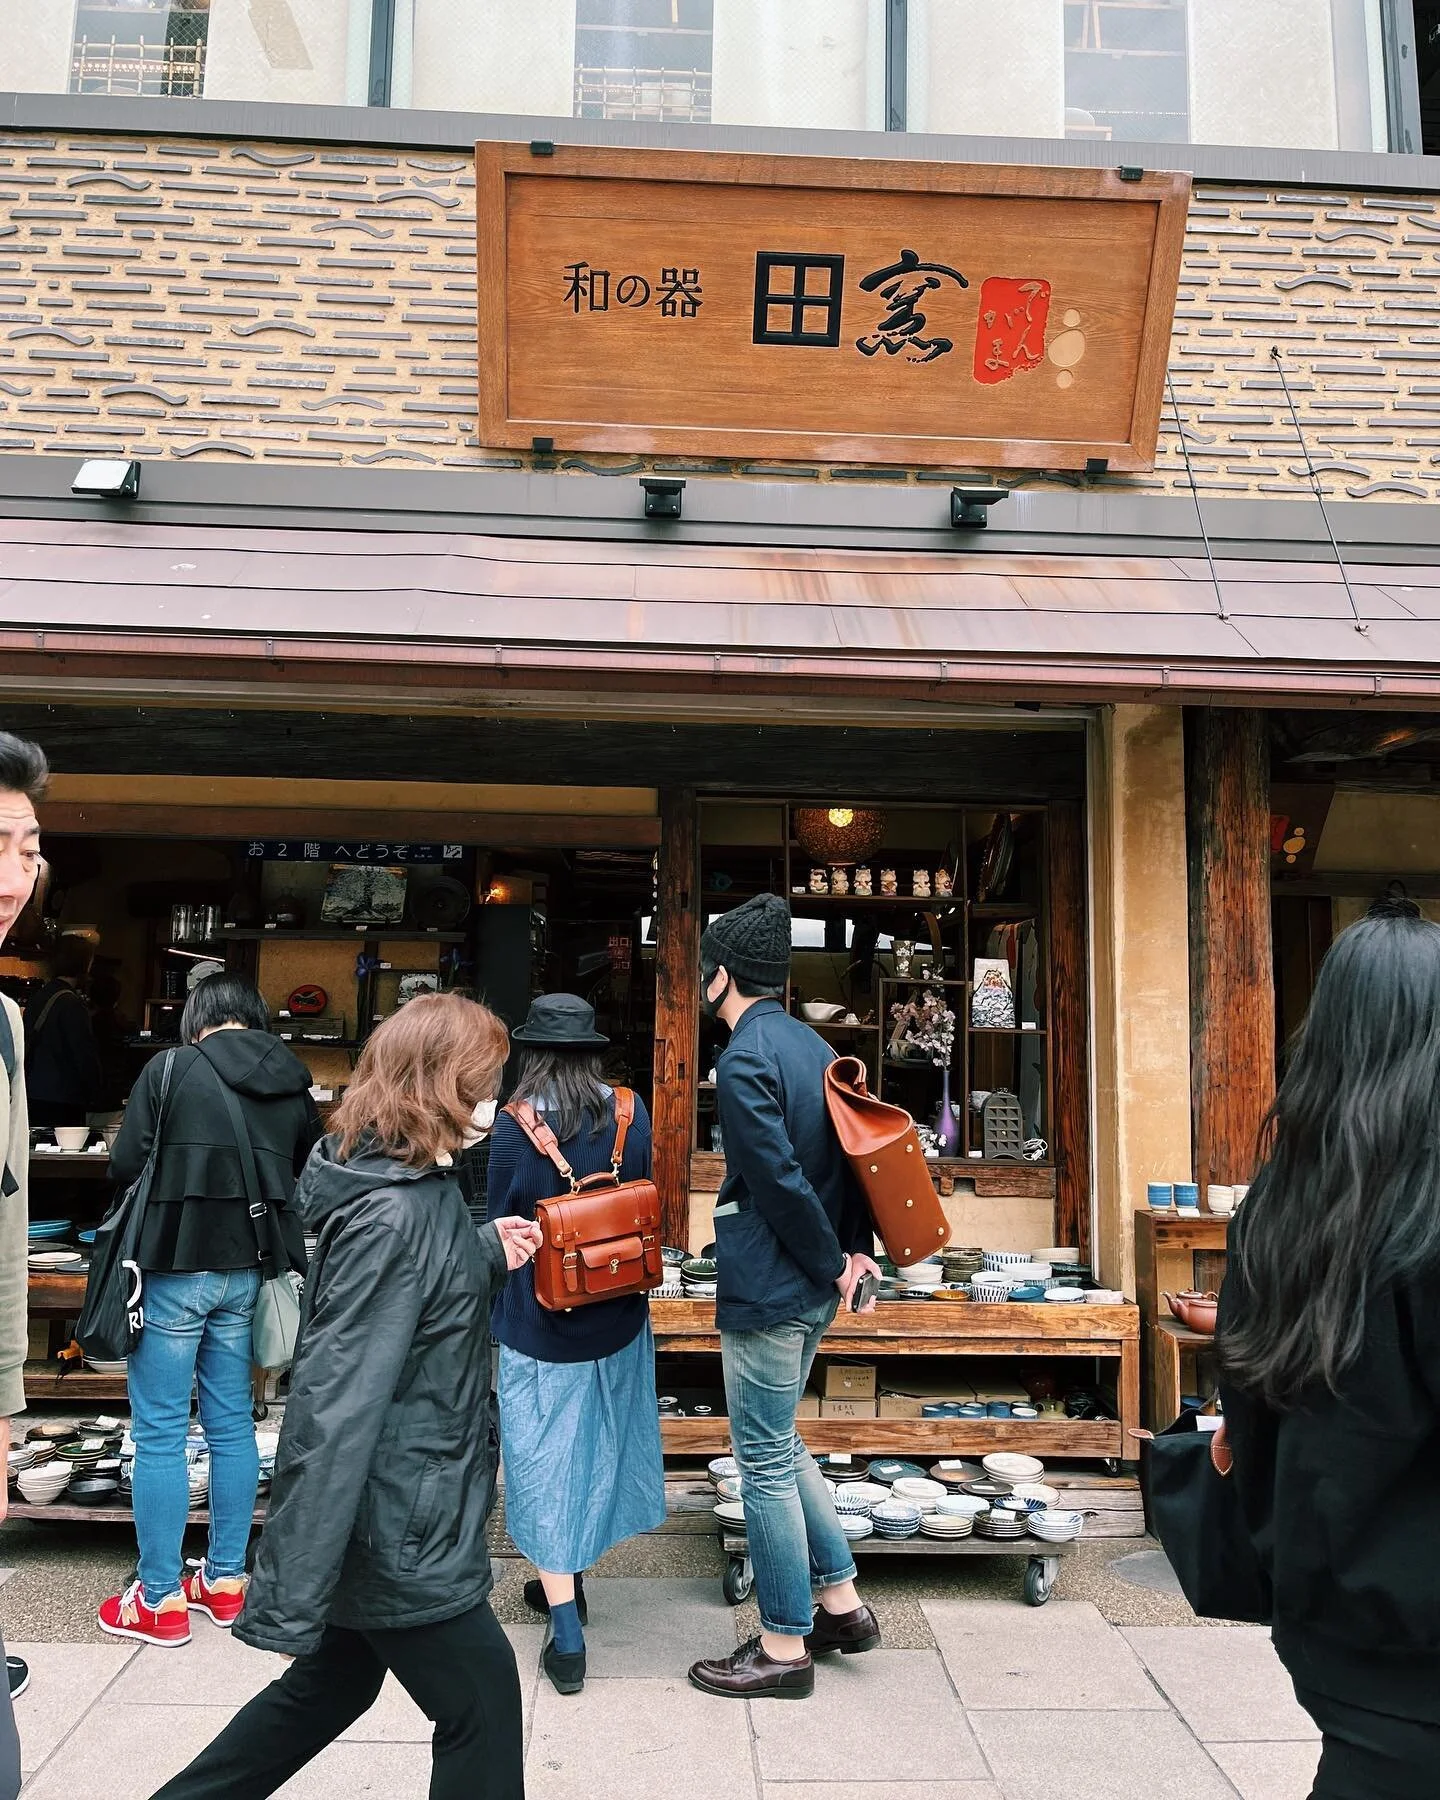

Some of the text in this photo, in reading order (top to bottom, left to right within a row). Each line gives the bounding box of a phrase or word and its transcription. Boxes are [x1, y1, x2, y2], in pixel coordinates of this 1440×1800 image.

[562, 261, 703, 318] 和の器
[121, 1601, 140, 1627] N
